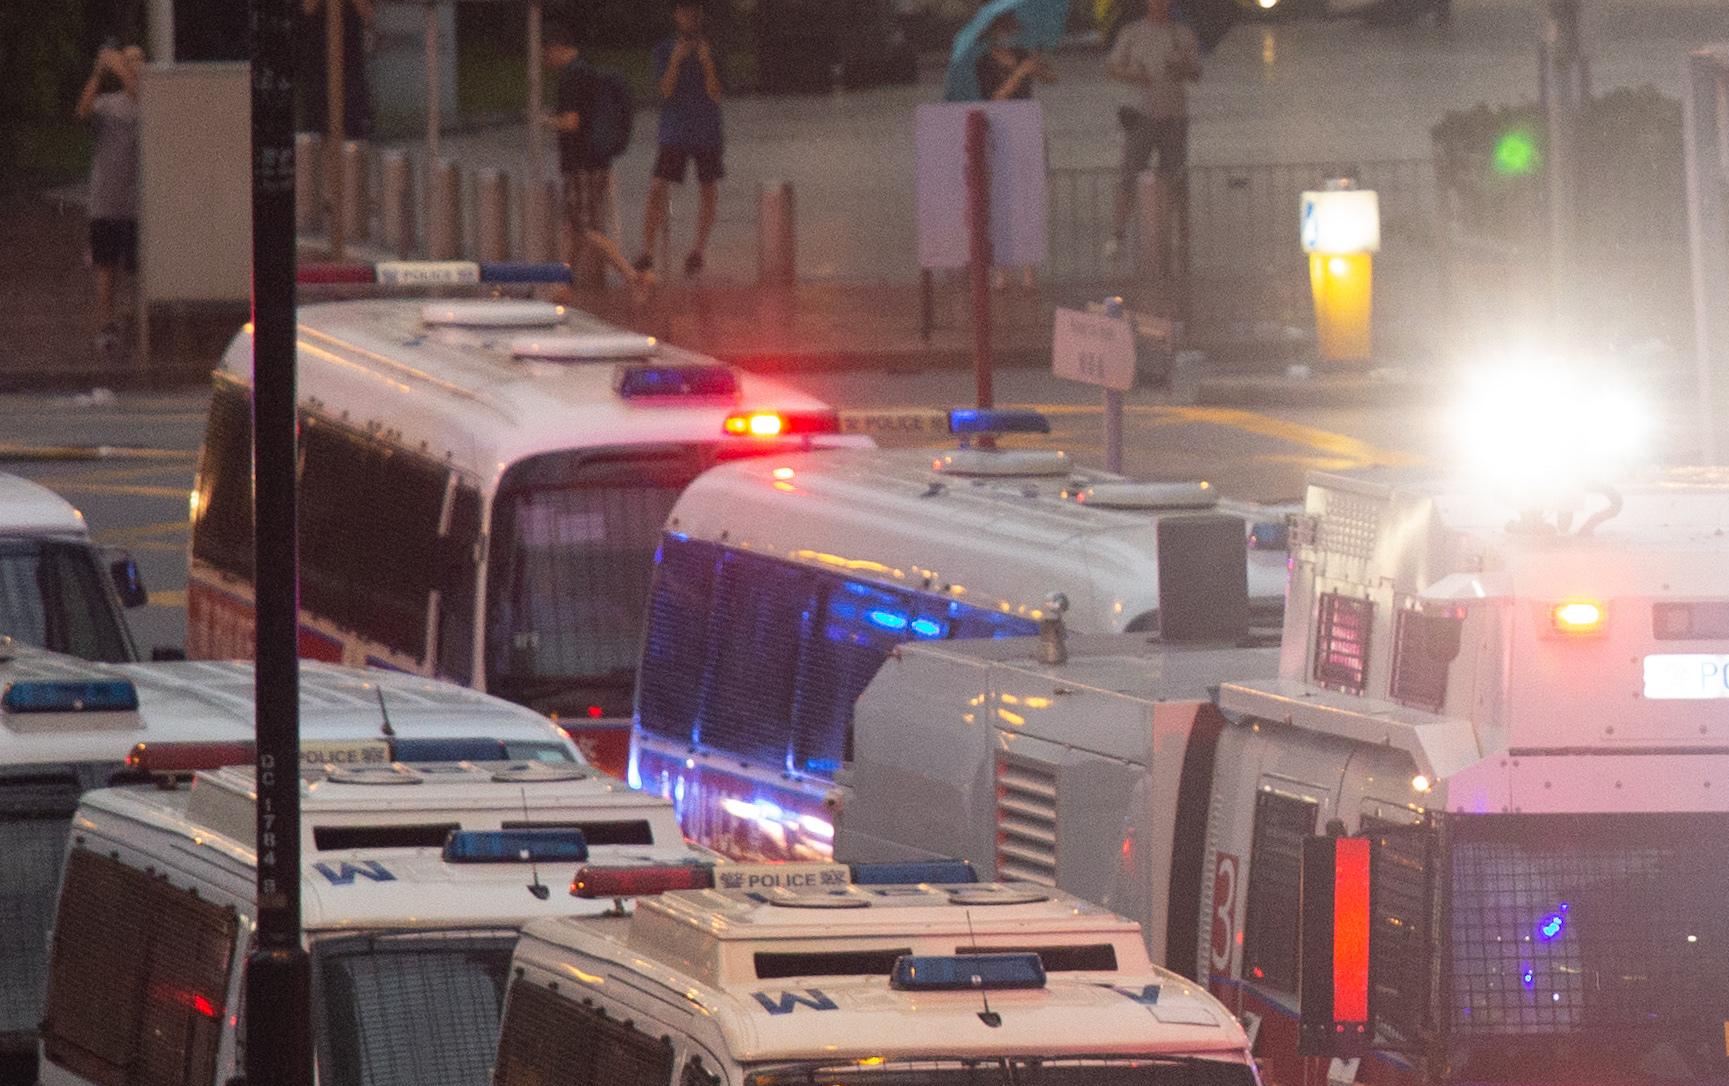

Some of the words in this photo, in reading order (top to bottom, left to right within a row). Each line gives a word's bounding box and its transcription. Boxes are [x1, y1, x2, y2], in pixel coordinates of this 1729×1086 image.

[300, 750, 357, 764] OLICE
[748, 873, 816, 888] POLICE
[1211, 857, 1235, 971] 3
